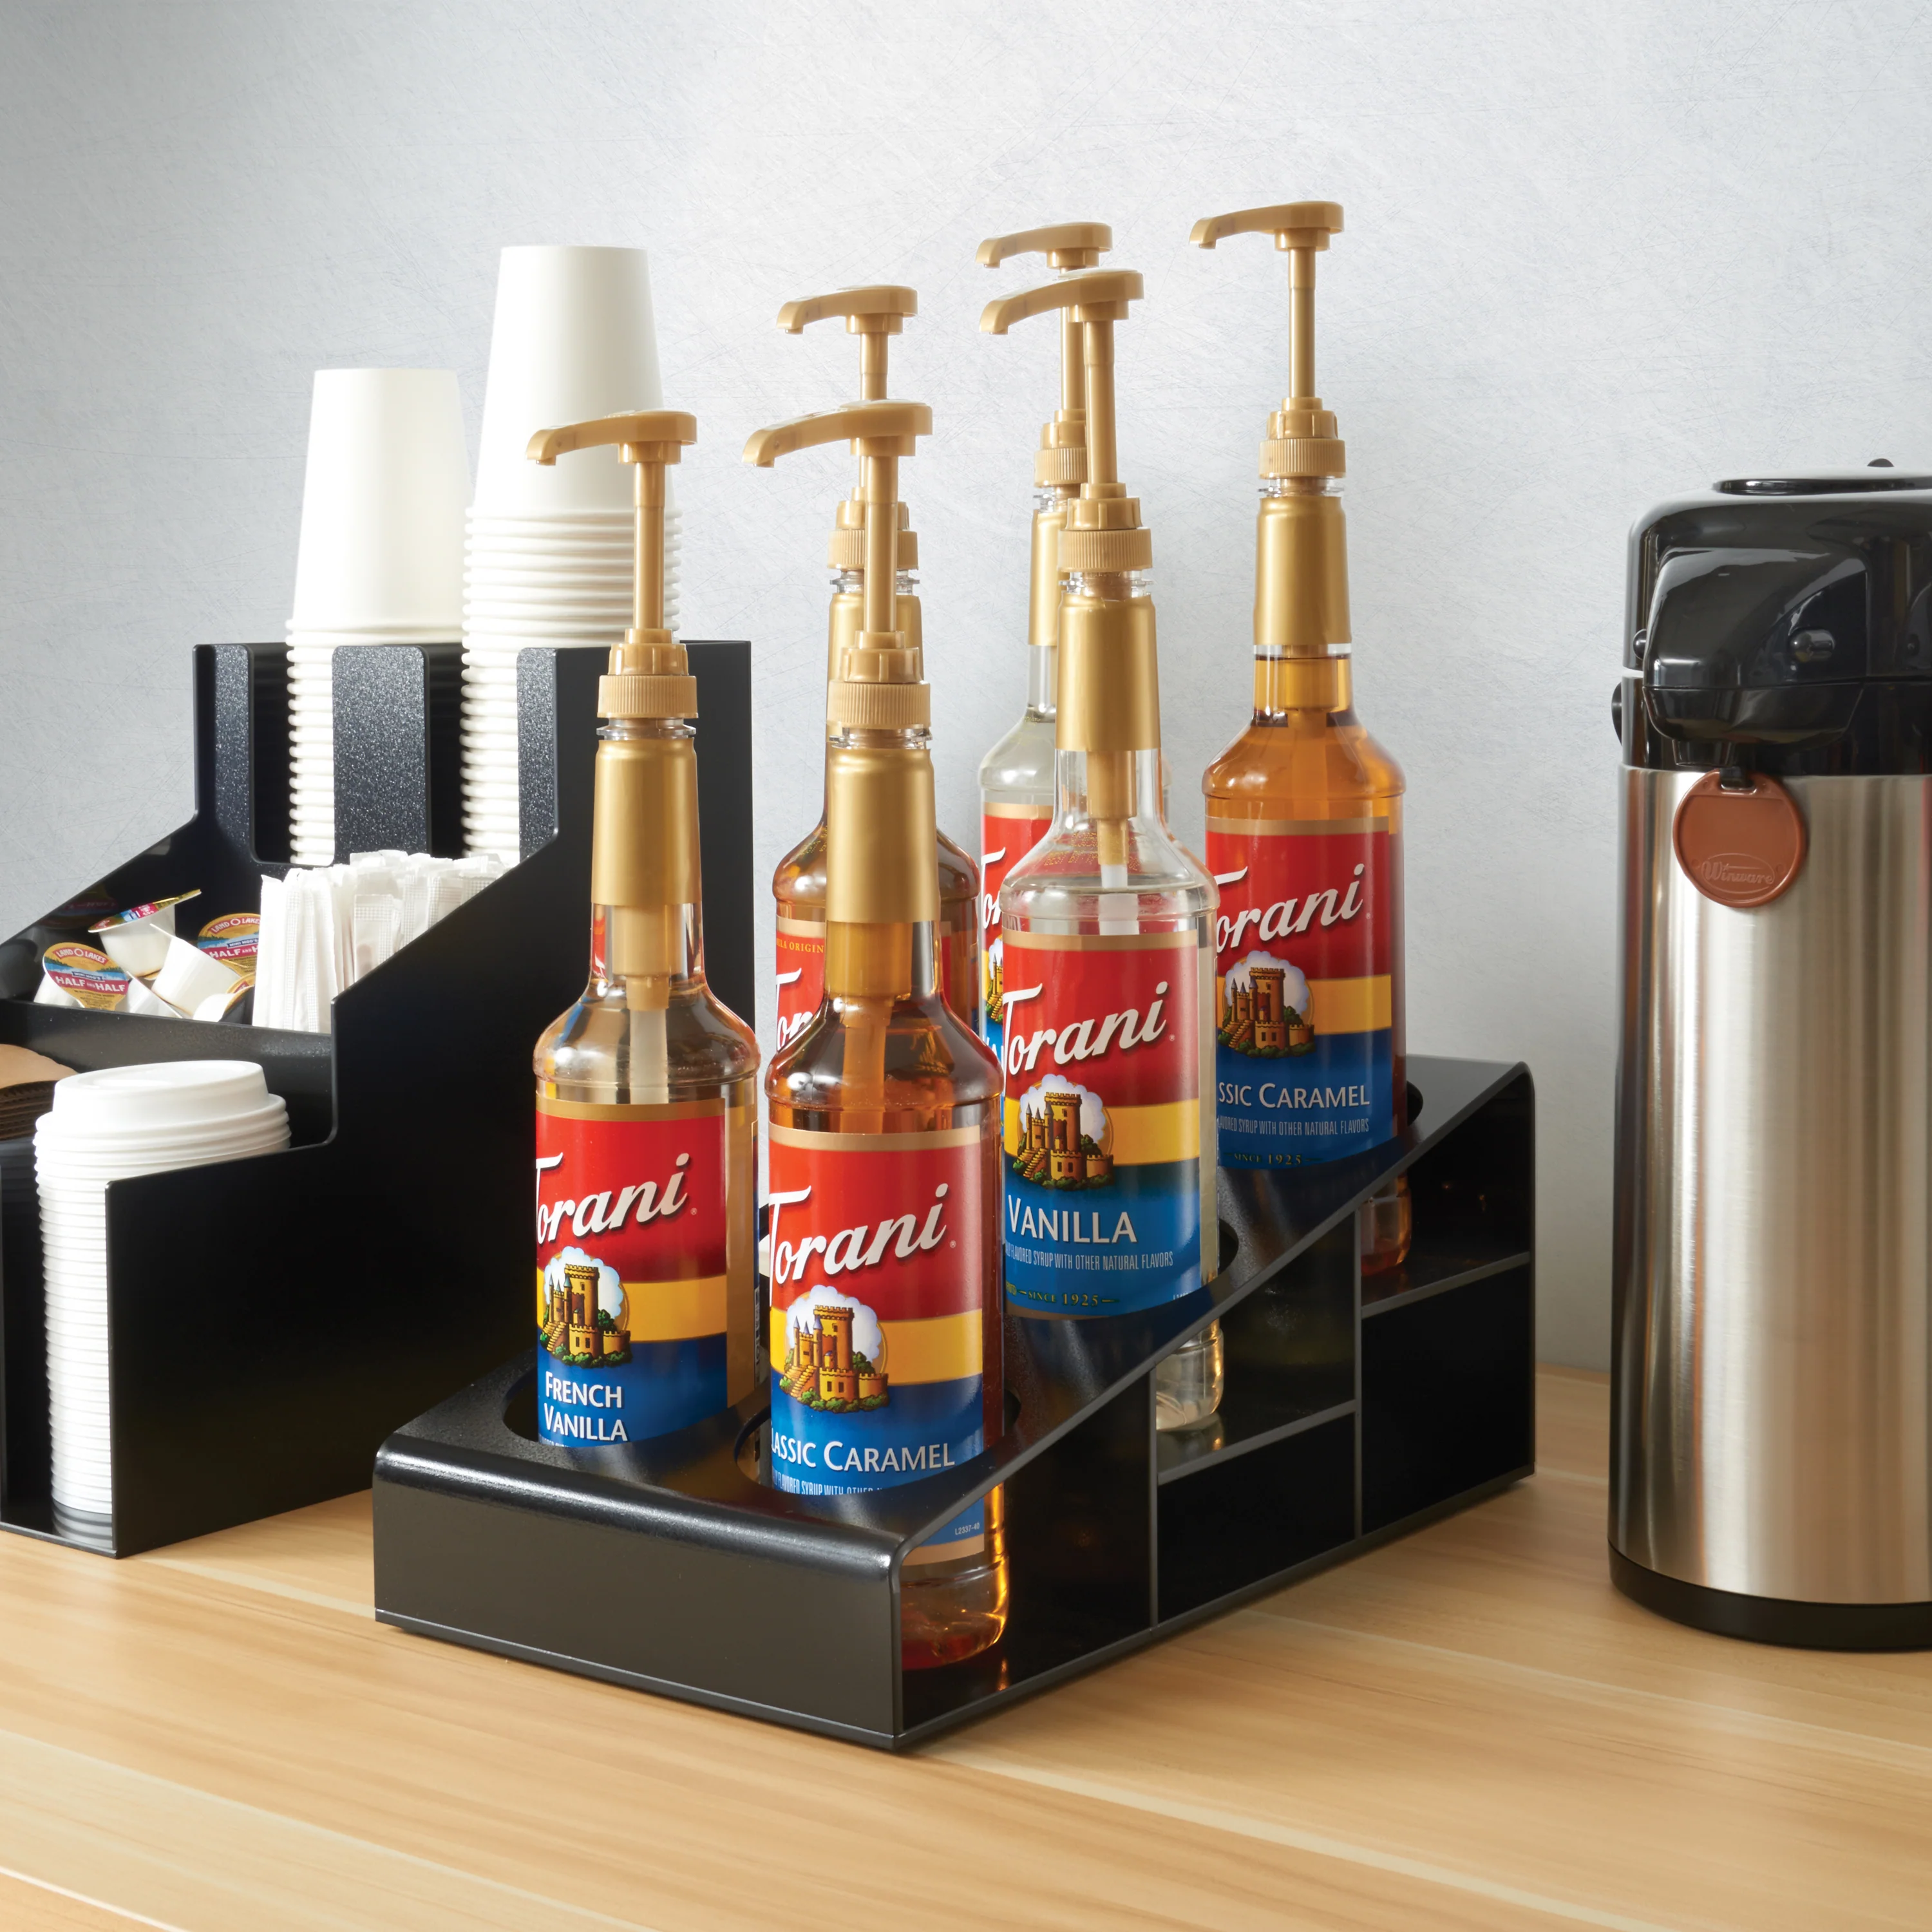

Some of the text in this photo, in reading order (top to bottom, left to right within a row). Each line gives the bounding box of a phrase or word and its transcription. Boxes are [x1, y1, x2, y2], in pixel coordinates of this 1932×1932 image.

[211, 922, 230, 933] LAND
[230, 918, 241, 926] O
[55, 948, 106, 964] LAND O LAKES
[209, 949, 241, 958] HALF
[789, 942, 824, 953] ORIGIN
[55, 976, 85, 987] HALF
[95, 983, 126, 992] HALF
[1003, 981, 1168, 1095] Torani
[1218, 1082, 1370, 1108] SSIC CARAMEL
[1238, 1118, 1258, 1133] SYRUP
[1258, 1121, 1276, 1135] WITH
[1279, 1121, 1302, 1135] OTHER
[1305, 1121, 1338, 1136] NATURAL
[1340, 1118, 1370, 1134] FLAVORS
[1267, 1153, 1302, 1165] 1925
[1008, 1195, 1137, 1243] VANILLA
[769, 1184, 948, 1306] Torani
[1033, 1250, 1053, 1267] SYRUP
[1054, 1253, 1072, 1269] WITH
[1075, 1255, 1100, 1271] OTHER
[1103, 1255, 1139, 1271] NATURAL
[1141, 1251, 1173, 1269] FLAVORS
[1028, 1289, 1098, 1307] SINCE 1925
[545, 1371, 622, 1408] FRENCH
[544, 1403, 628, 1441] VANILLA
[772, 1428, 956, 1472] LASSIC CARAMEL
[954, 1522, 980, 1535] L2337-40
